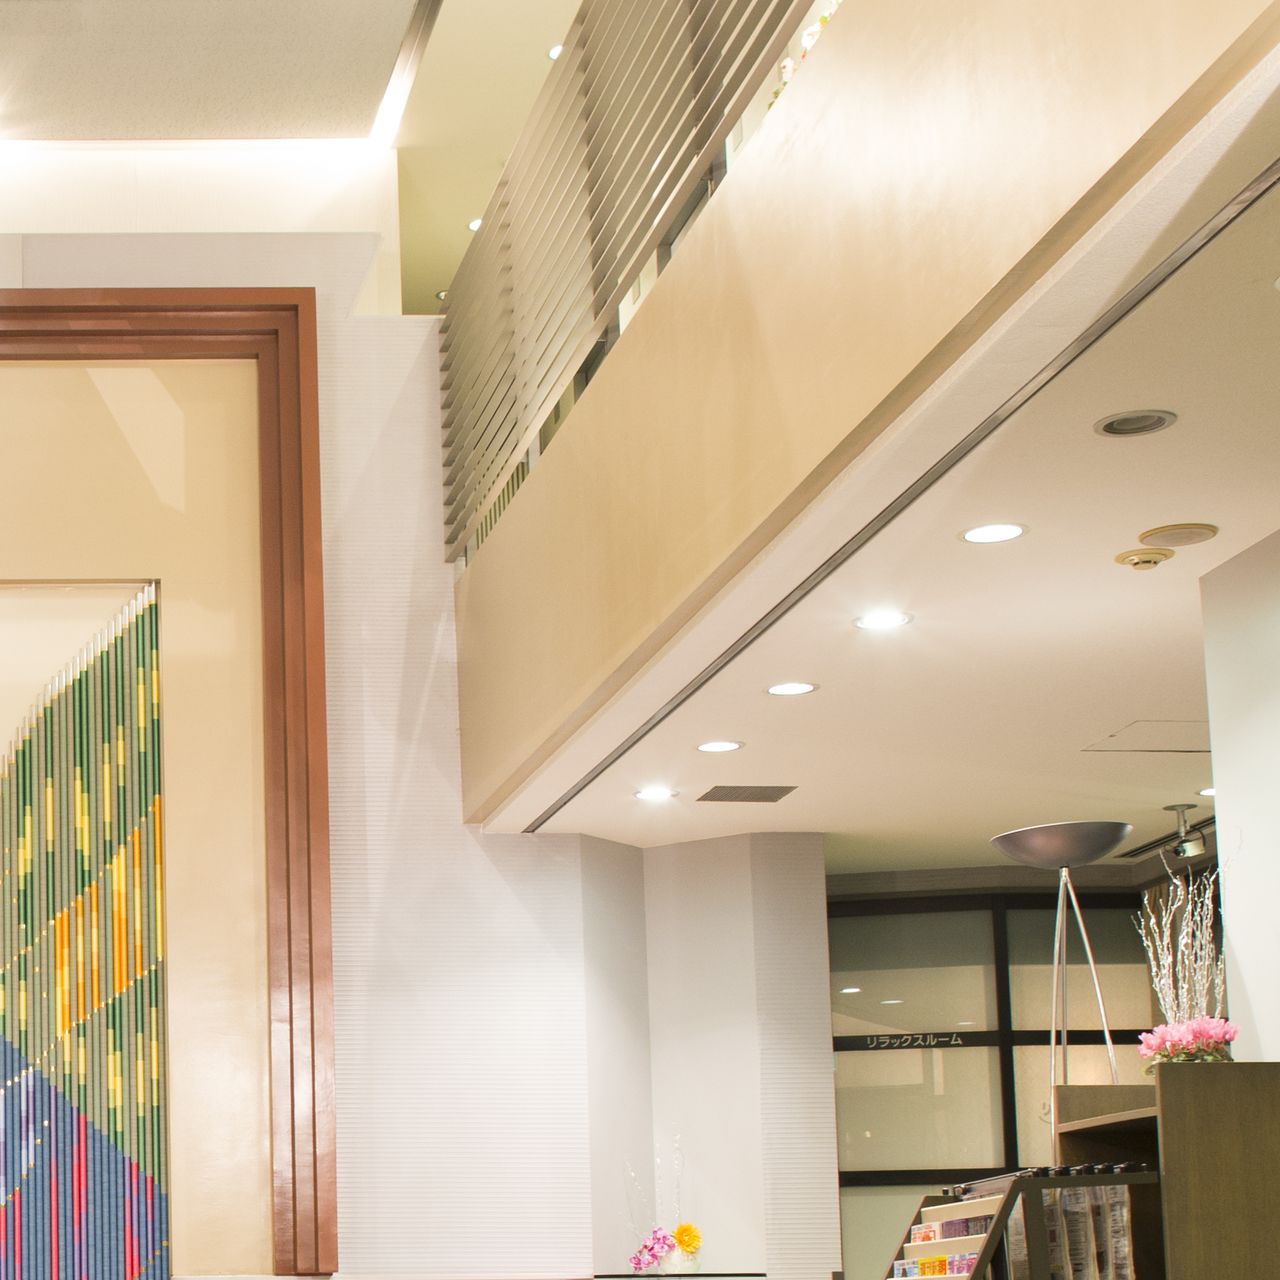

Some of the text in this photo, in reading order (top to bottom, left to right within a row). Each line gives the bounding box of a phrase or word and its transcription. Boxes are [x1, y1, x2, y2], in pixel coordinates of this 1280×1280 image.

[866, 1033, 963, 1048] リラックスルーム
